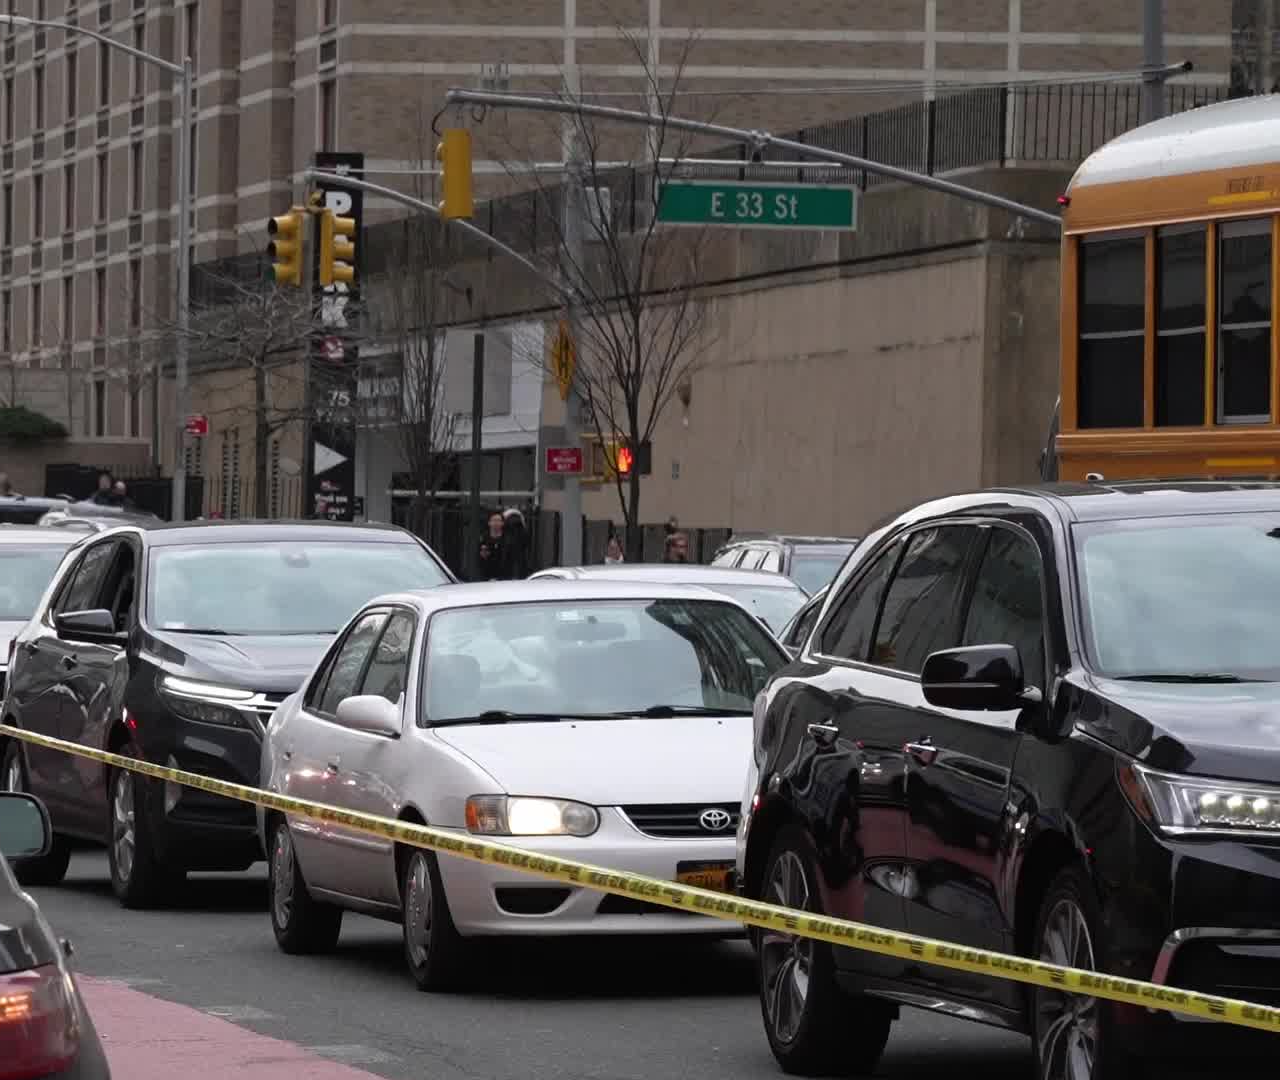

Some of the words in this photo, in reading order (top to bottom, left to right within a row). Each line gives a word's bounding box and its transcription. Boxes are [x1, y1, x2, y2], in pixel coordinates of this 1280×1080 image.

[711, 191, 724, 217] E
[736, 192, 763, 218] 33
[774, 194, 798, 219] St
